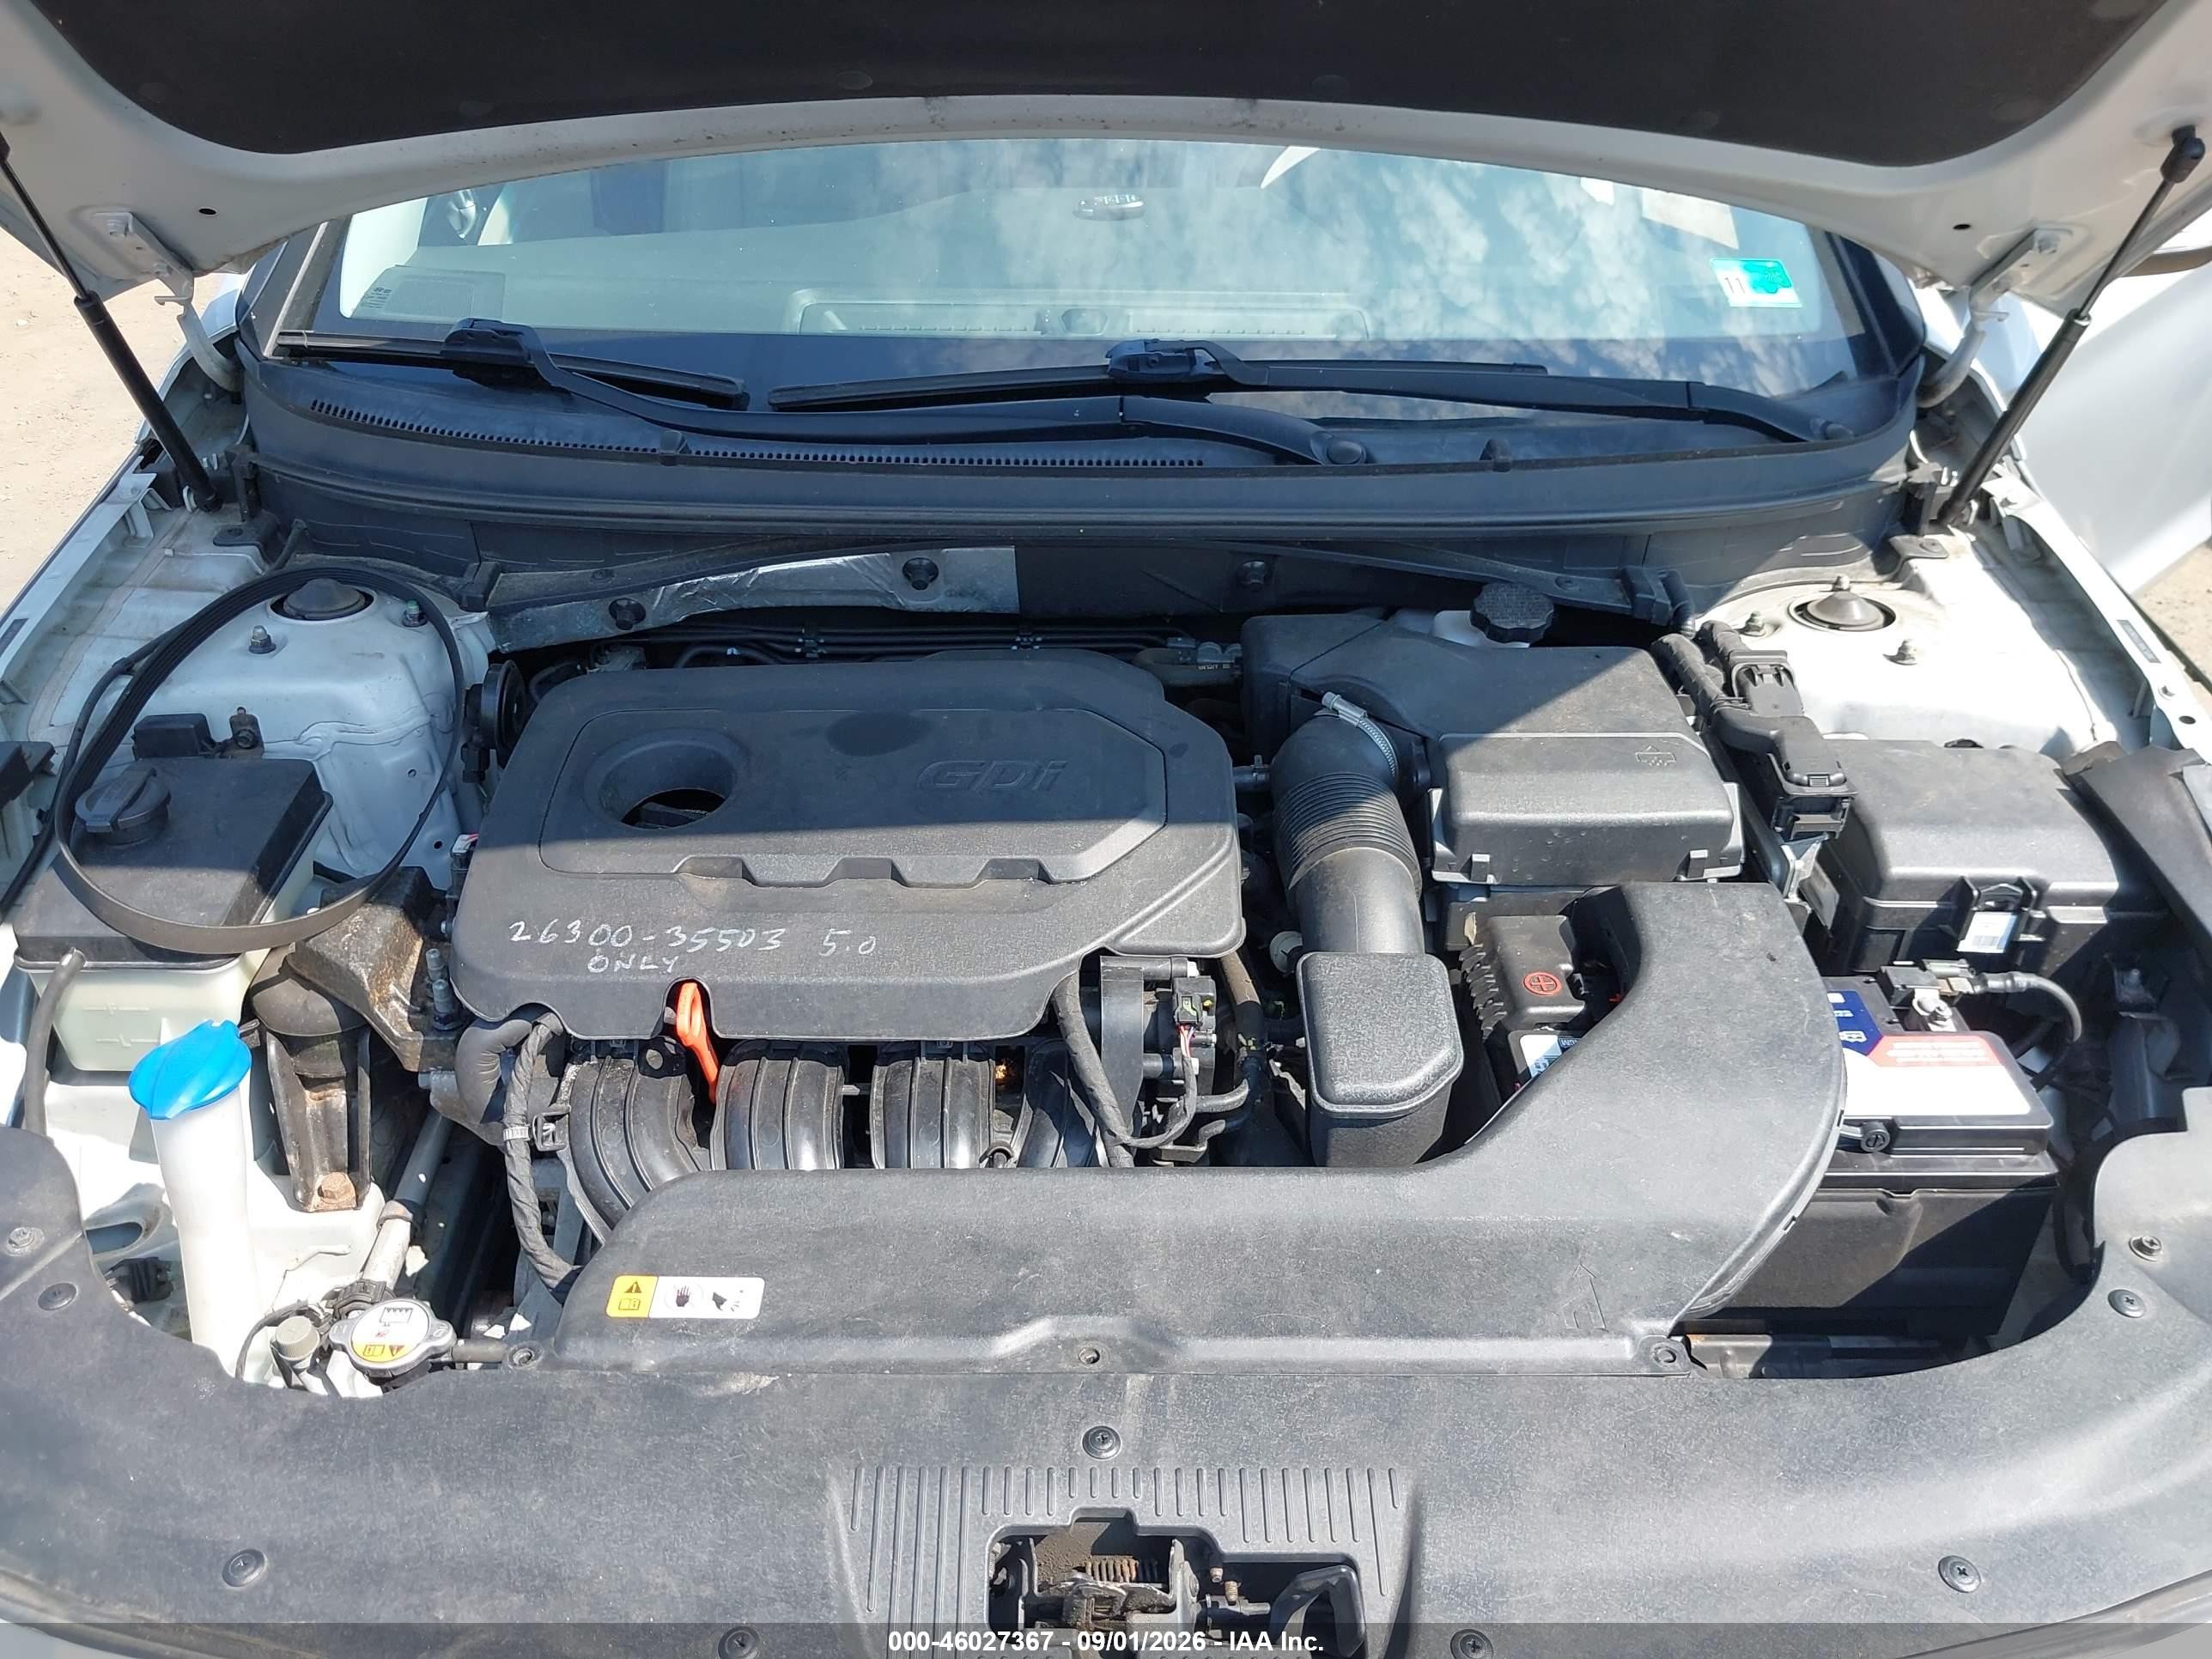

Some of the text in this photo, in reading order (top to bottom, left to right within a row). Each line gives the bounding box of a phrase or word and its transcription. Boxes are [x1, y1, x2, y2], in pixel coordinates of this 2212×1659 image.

[508, 919, 877, 957] 26300-35503 5.0
[587, 953, 679, 974] ONLY
